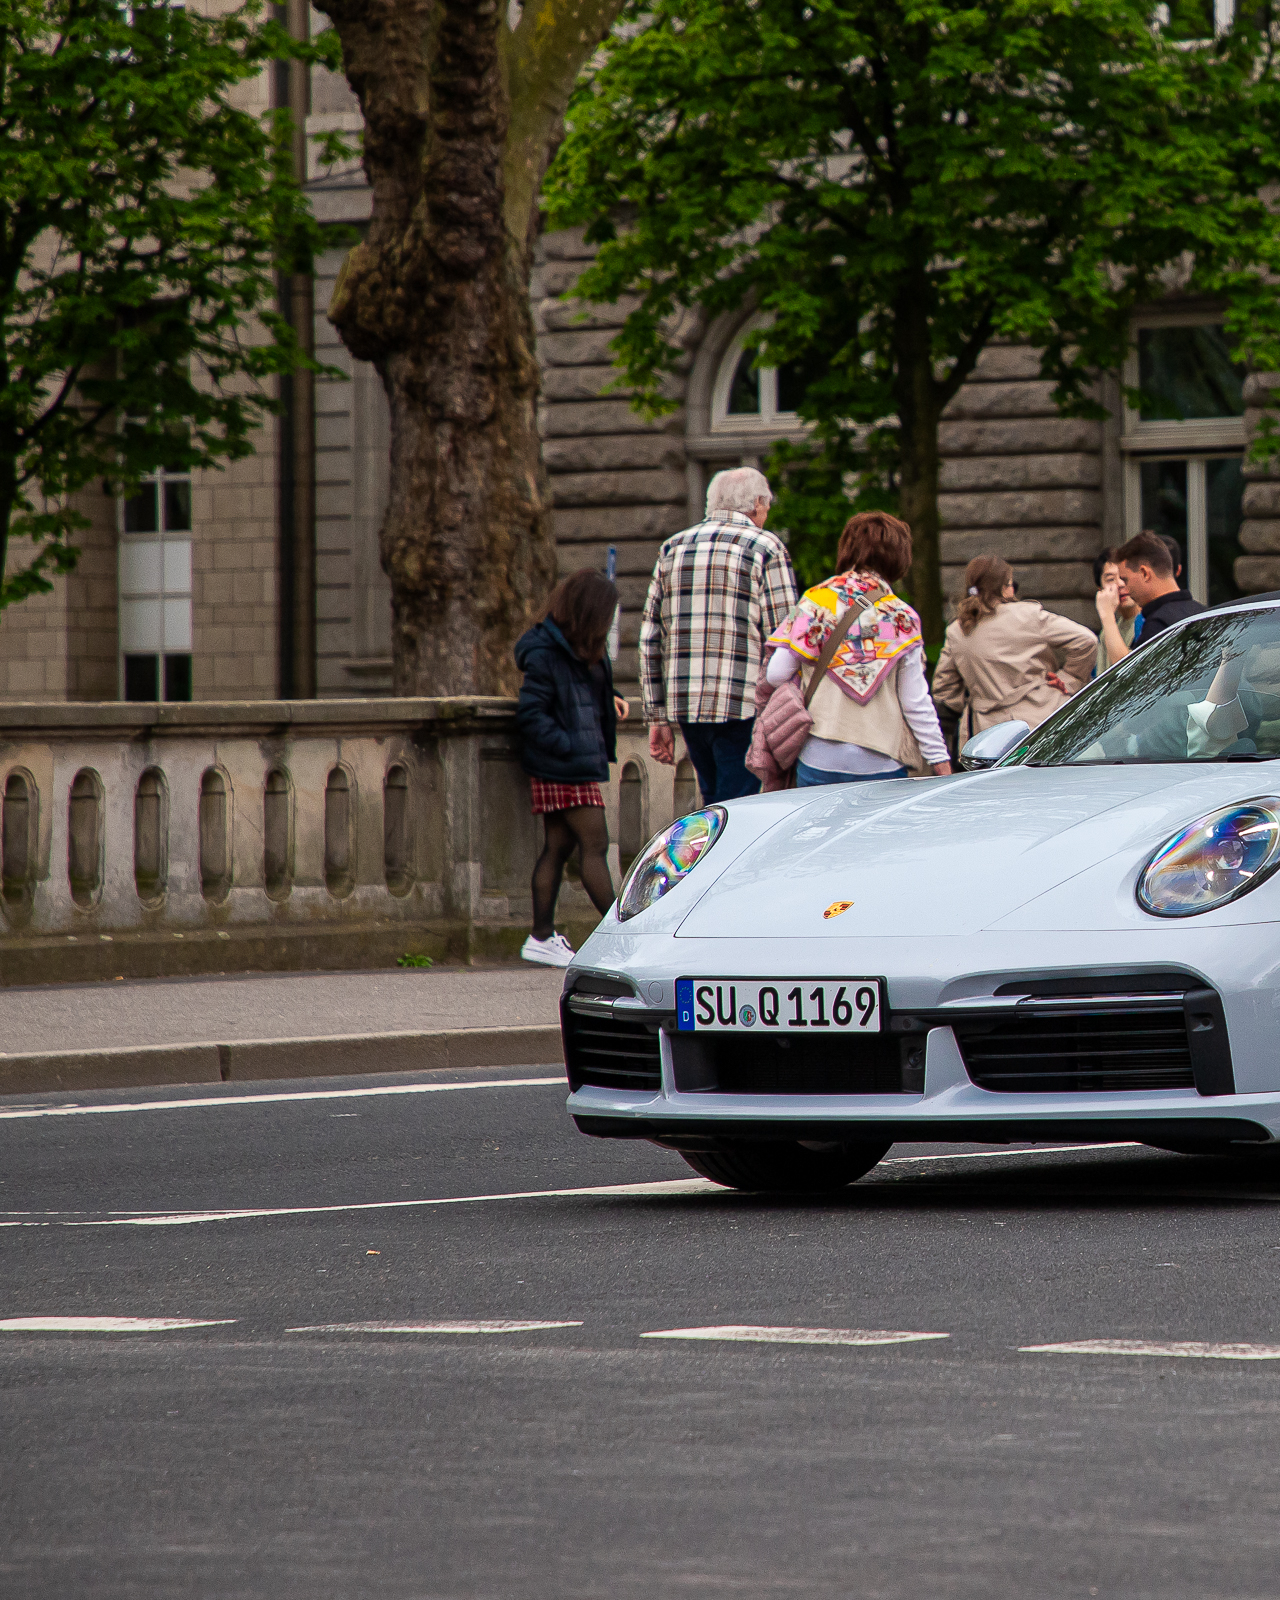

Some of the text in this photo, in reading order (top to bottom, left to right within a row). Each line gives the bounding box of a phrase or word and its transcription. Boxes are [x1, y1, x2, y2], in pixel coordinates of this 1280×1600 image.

[682, 1010, 690, 1022] D
[696, 986, 876, 1027] SU Q 1169
